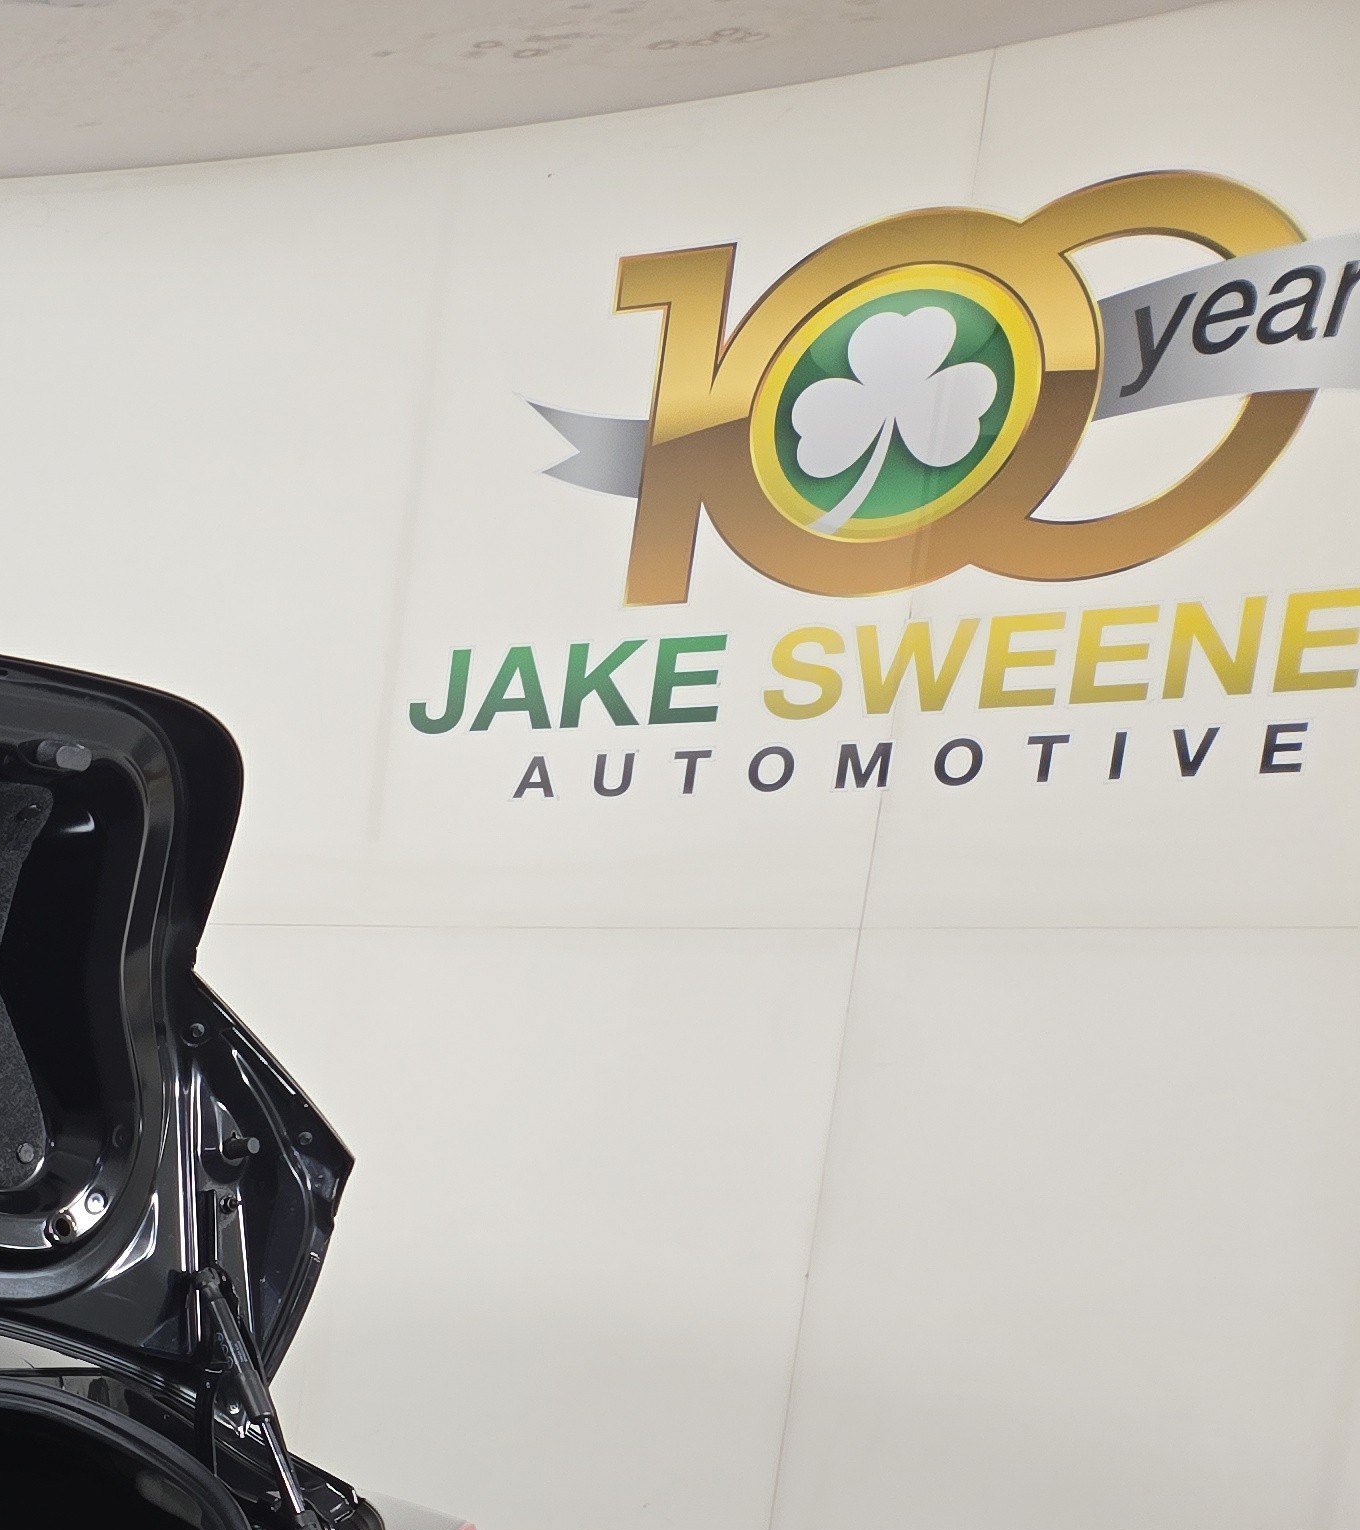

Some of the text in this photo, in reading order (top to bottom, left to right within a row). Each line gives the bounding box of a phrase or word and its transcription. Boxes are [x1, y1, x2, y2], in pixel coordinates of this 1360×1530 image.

[1119, 259, 1360, 398] year
[408, 586, 1360, 736] JAKE SWEENE
[512, 721, 1309, 800] AUTOMOTIVE
